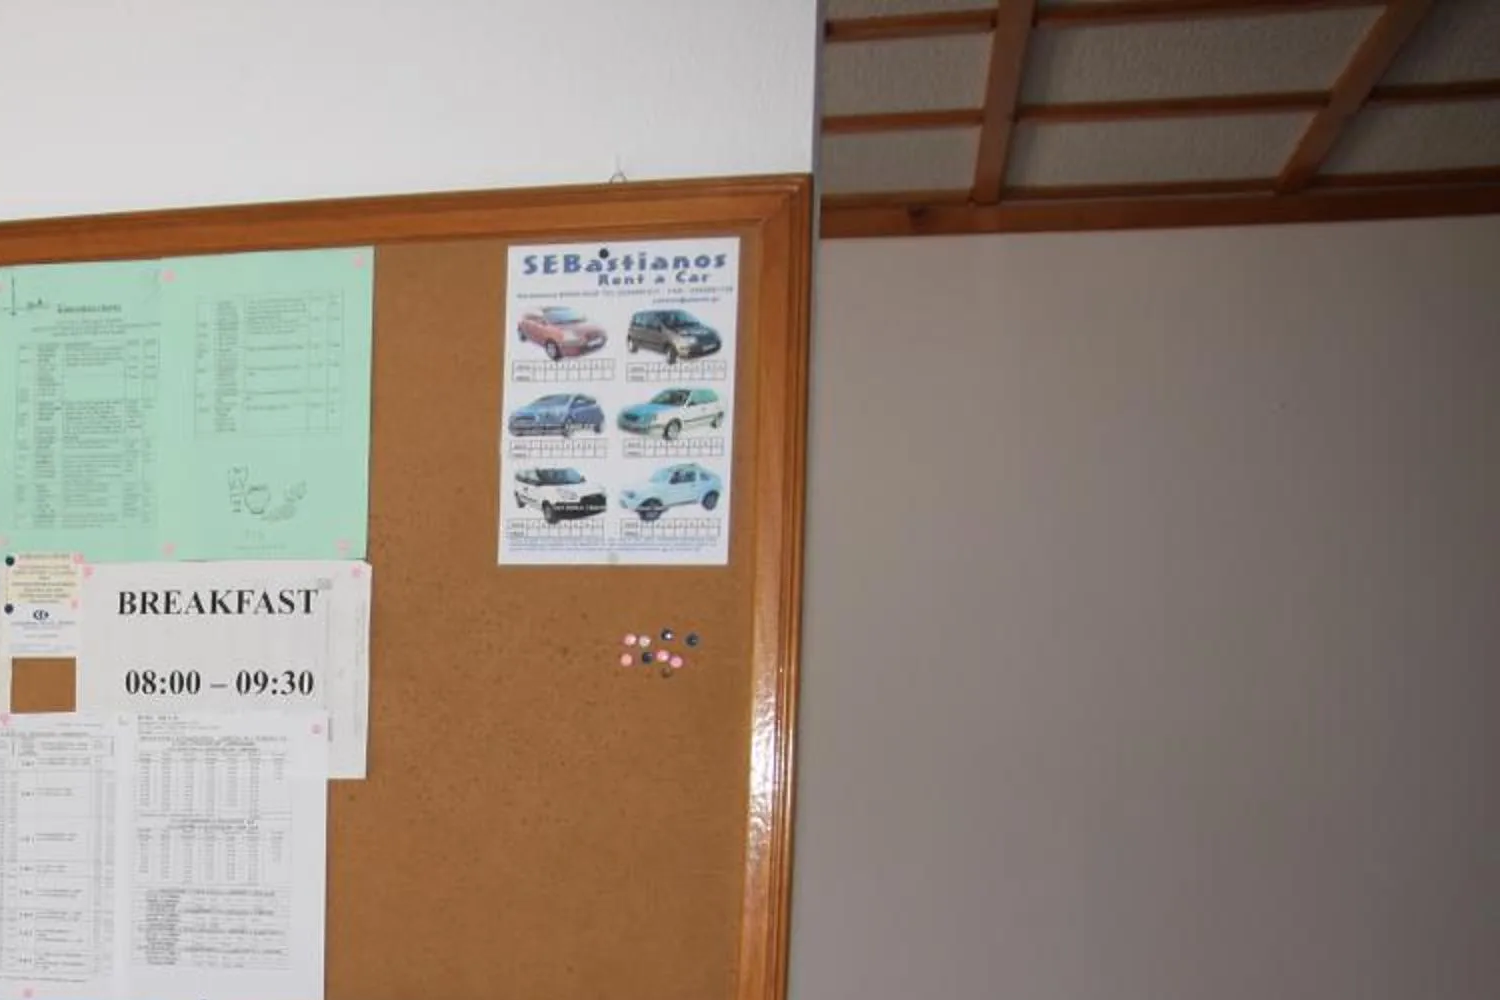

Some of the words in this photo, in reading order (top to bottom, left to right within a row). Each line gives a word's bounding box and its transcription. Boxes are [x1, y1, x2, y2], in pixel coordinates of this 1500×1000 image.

[522, 252, 726, 275] SEBastianos
[598, 273, 644, 286] Rent
[675, 271, 711, 284] Car
[117, 589, 318, 616] BREAKFAST
[124, 671, 201, 696] 08:00
[235, 671, 314, 696] 09:30
